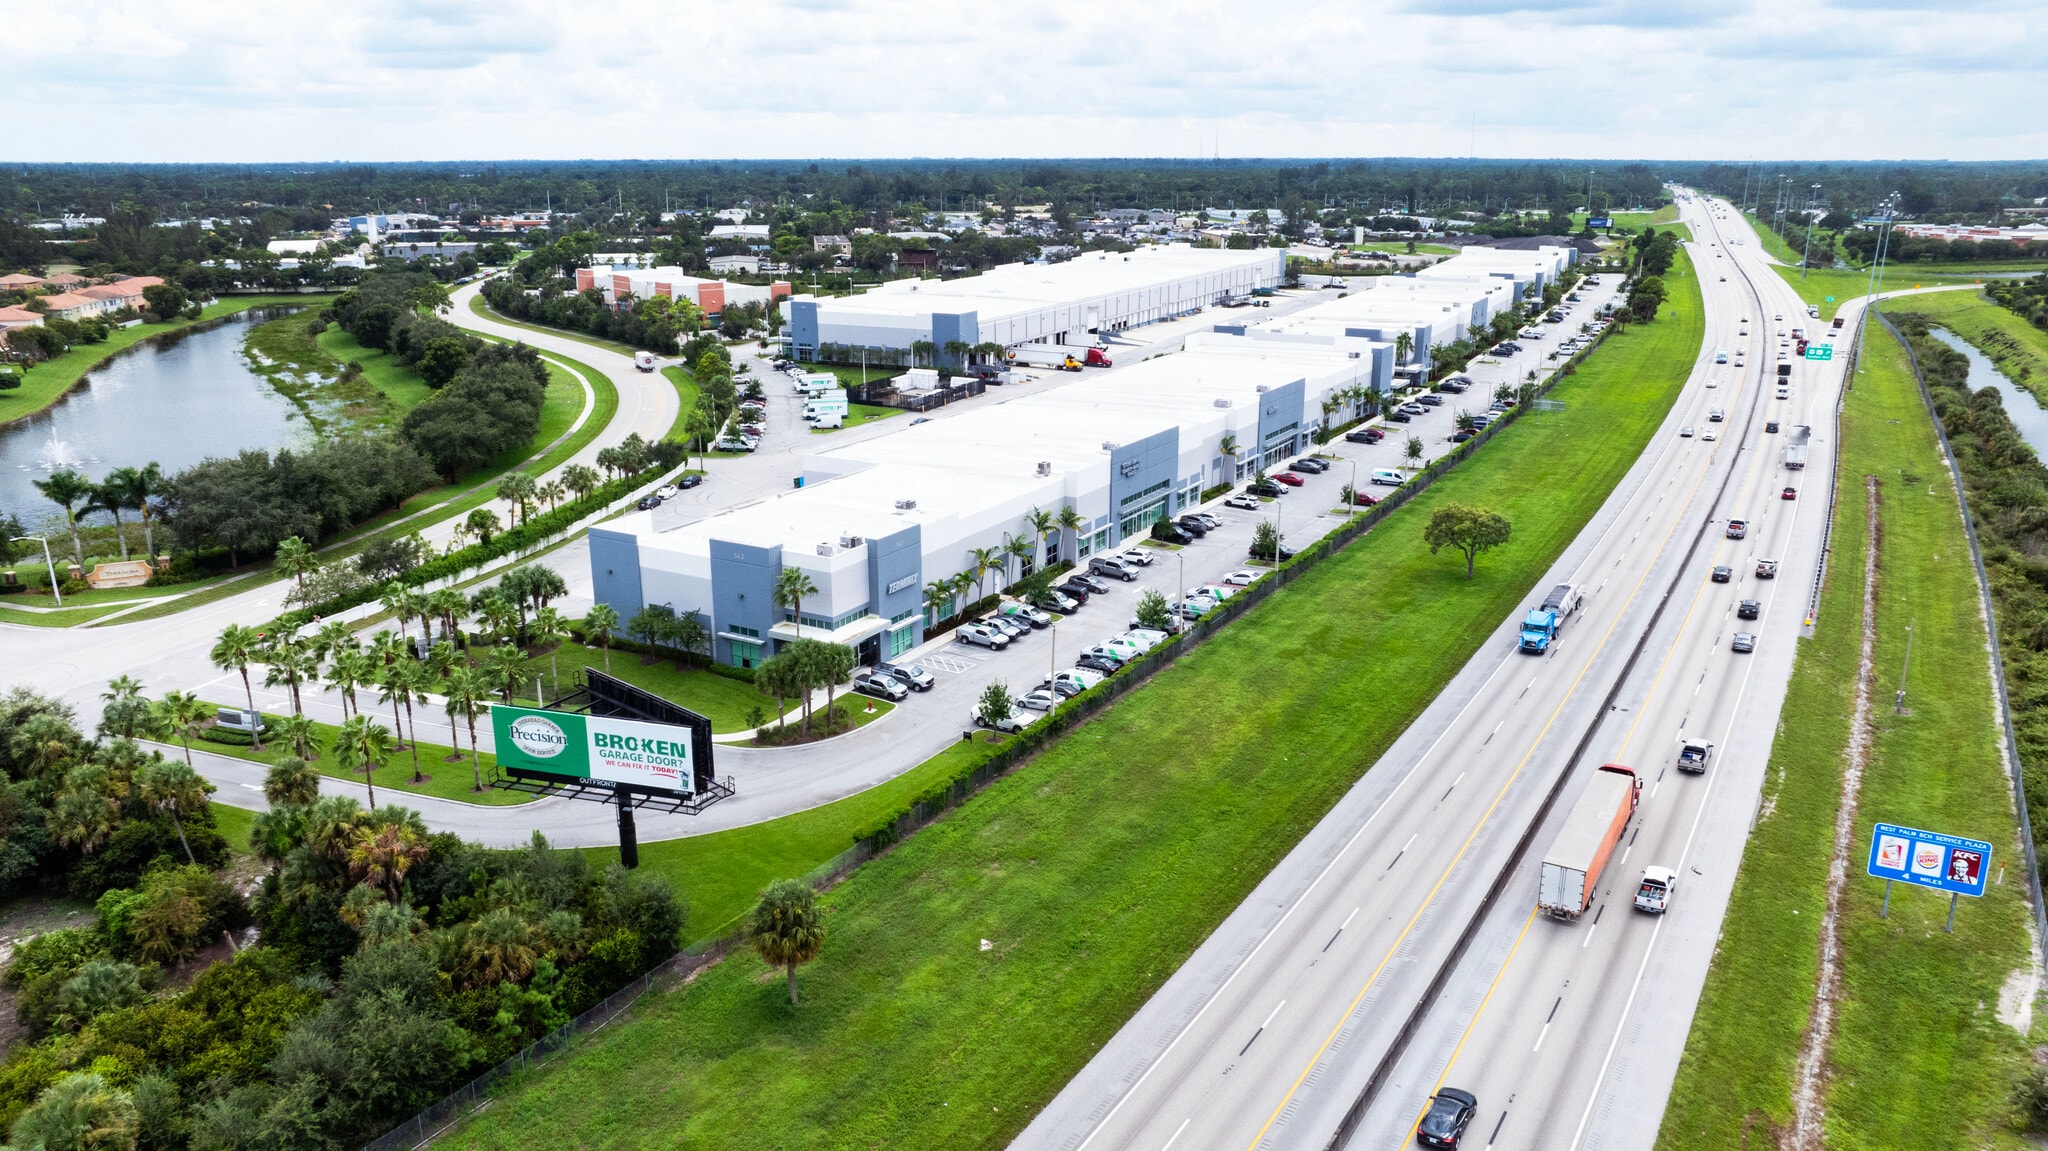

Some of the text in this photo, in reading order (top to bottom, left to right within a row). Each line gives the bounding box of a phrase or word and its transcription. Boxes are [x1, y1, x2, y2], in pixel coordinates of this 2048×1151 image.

[510, 726, 567, 745] Precision
[594, 732, 686, 758] BROKEN
[600, 749, 683, 768] GARAGE DOOR?
[652, 766, 678, 774] TODAY!
[1900, 829, 1916, 837] PALM
[1936, 835, 1962, 845] SERVICE
[1965, 841, 1987, 850] PLAZA
[1953, 850, 1980, 861] KFC
[1920, 876, 1942, 886] MILES
